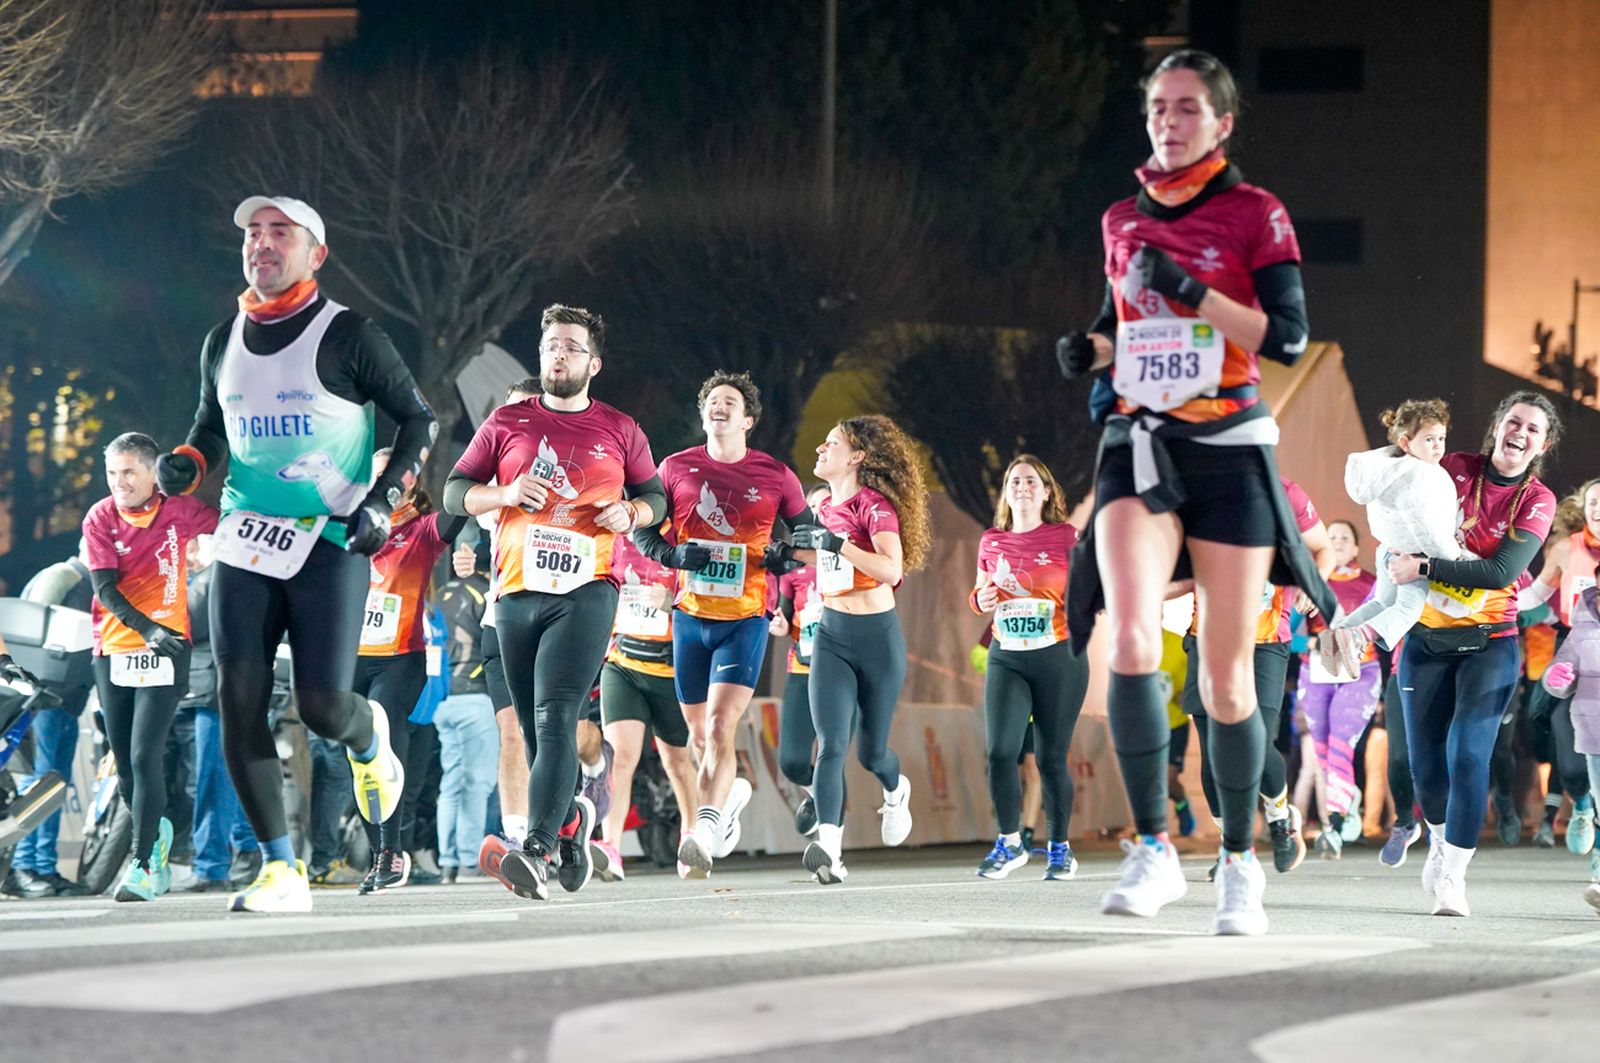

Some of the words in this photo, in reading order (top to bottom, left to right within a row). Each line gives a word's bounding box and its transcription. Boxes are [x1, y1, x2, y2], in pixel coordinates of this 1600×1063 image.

[1136, 288, 1158, 315] 43
[1136, 352, 1200, 382] 7583
[251, 414, 314, 438] GILETE
[707, 511, 724, 527] 43
[237, 517, 296, 551] 5746
[541, 533, 562, 542] NOCHE
[532, 540, 545, 548] SAN
[536, 549, 582, 574] 5087
[1002, 578, 1017, 592] 43
[366, 611, 384, 628] 79
[1003, 617, 1045, 633] 13754
[125, 654, 159, 670] 7180
